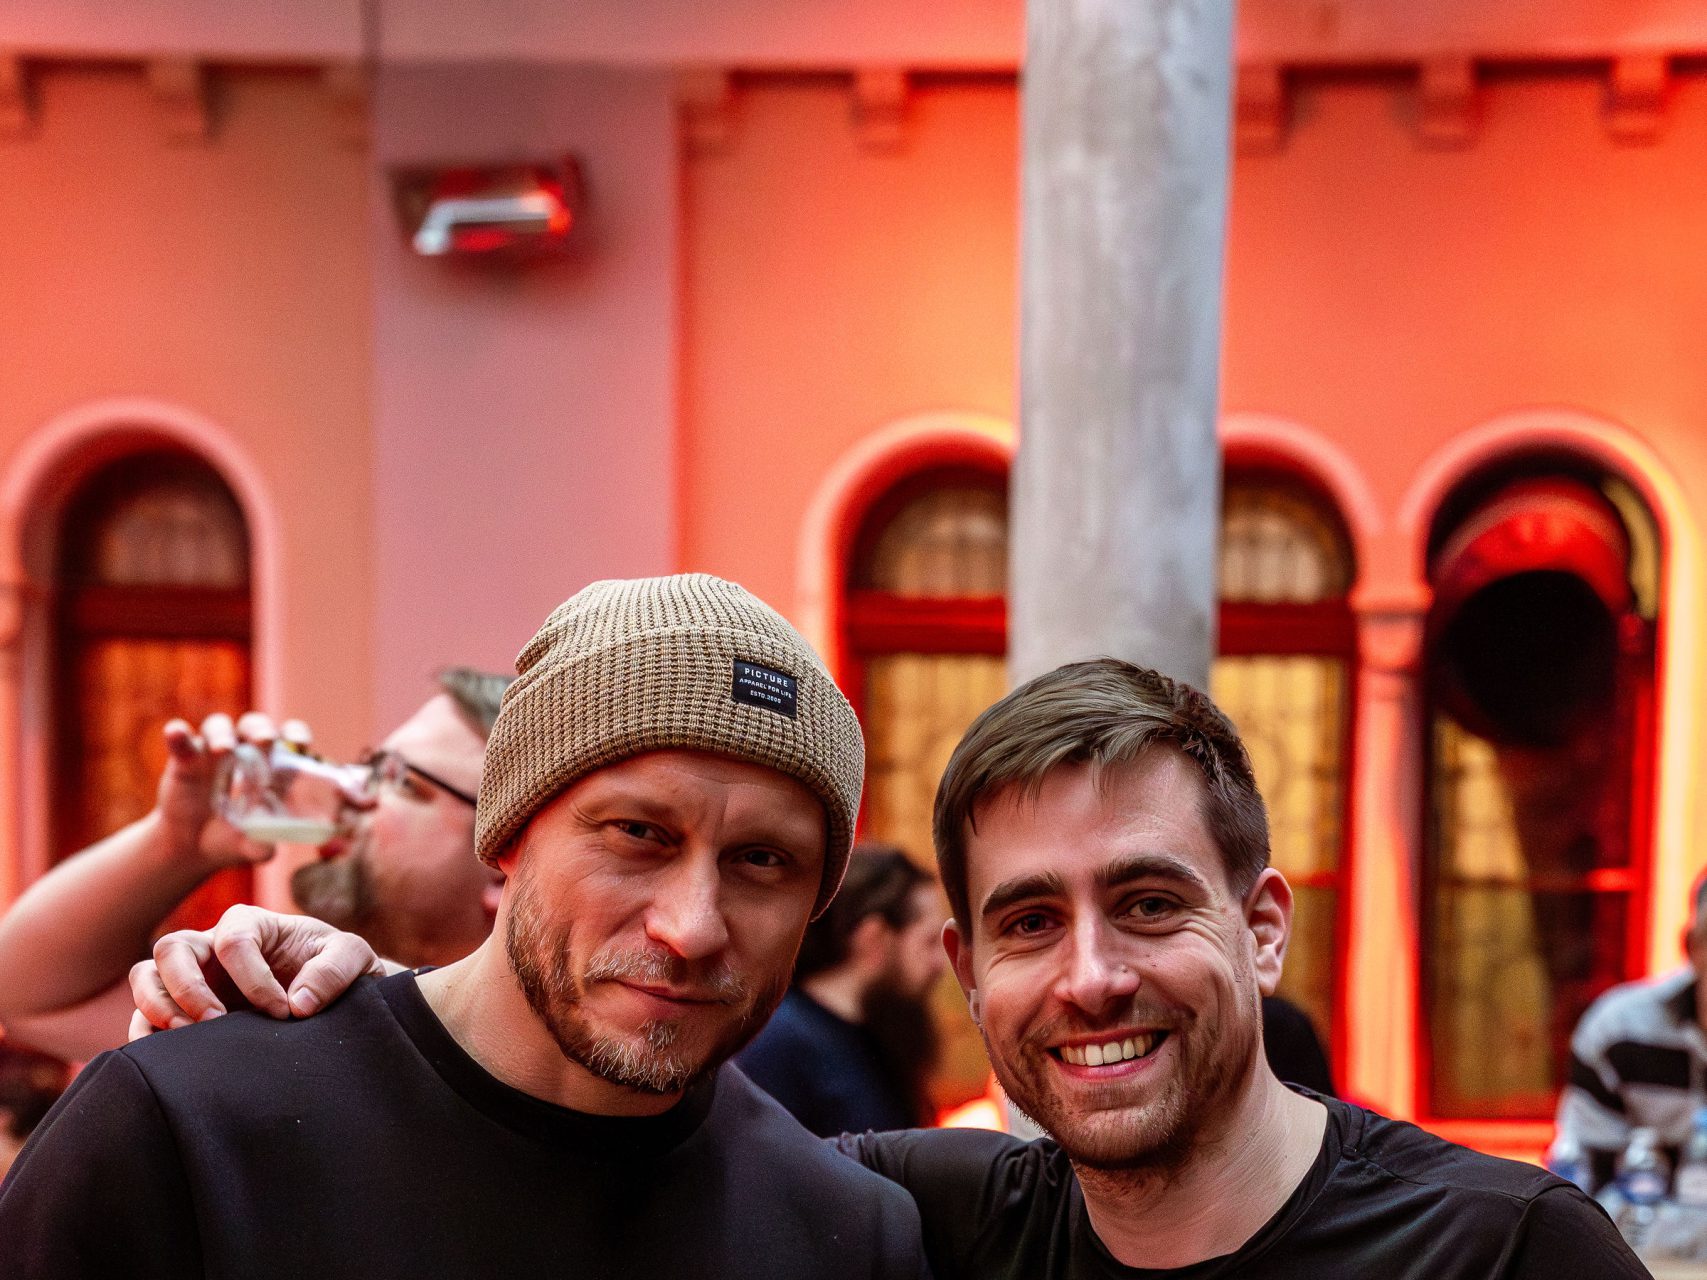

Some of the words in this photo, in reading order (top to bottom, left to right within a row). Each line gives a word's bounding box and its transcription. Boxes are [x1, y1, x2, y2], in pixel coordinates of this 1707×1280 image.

[744, 667, 788, 688] PICTURE
[739, 678, 768, 690] APPAREL
[767, 685, 780, 694] FOR
[780, 689, 793, 699] LIFE
